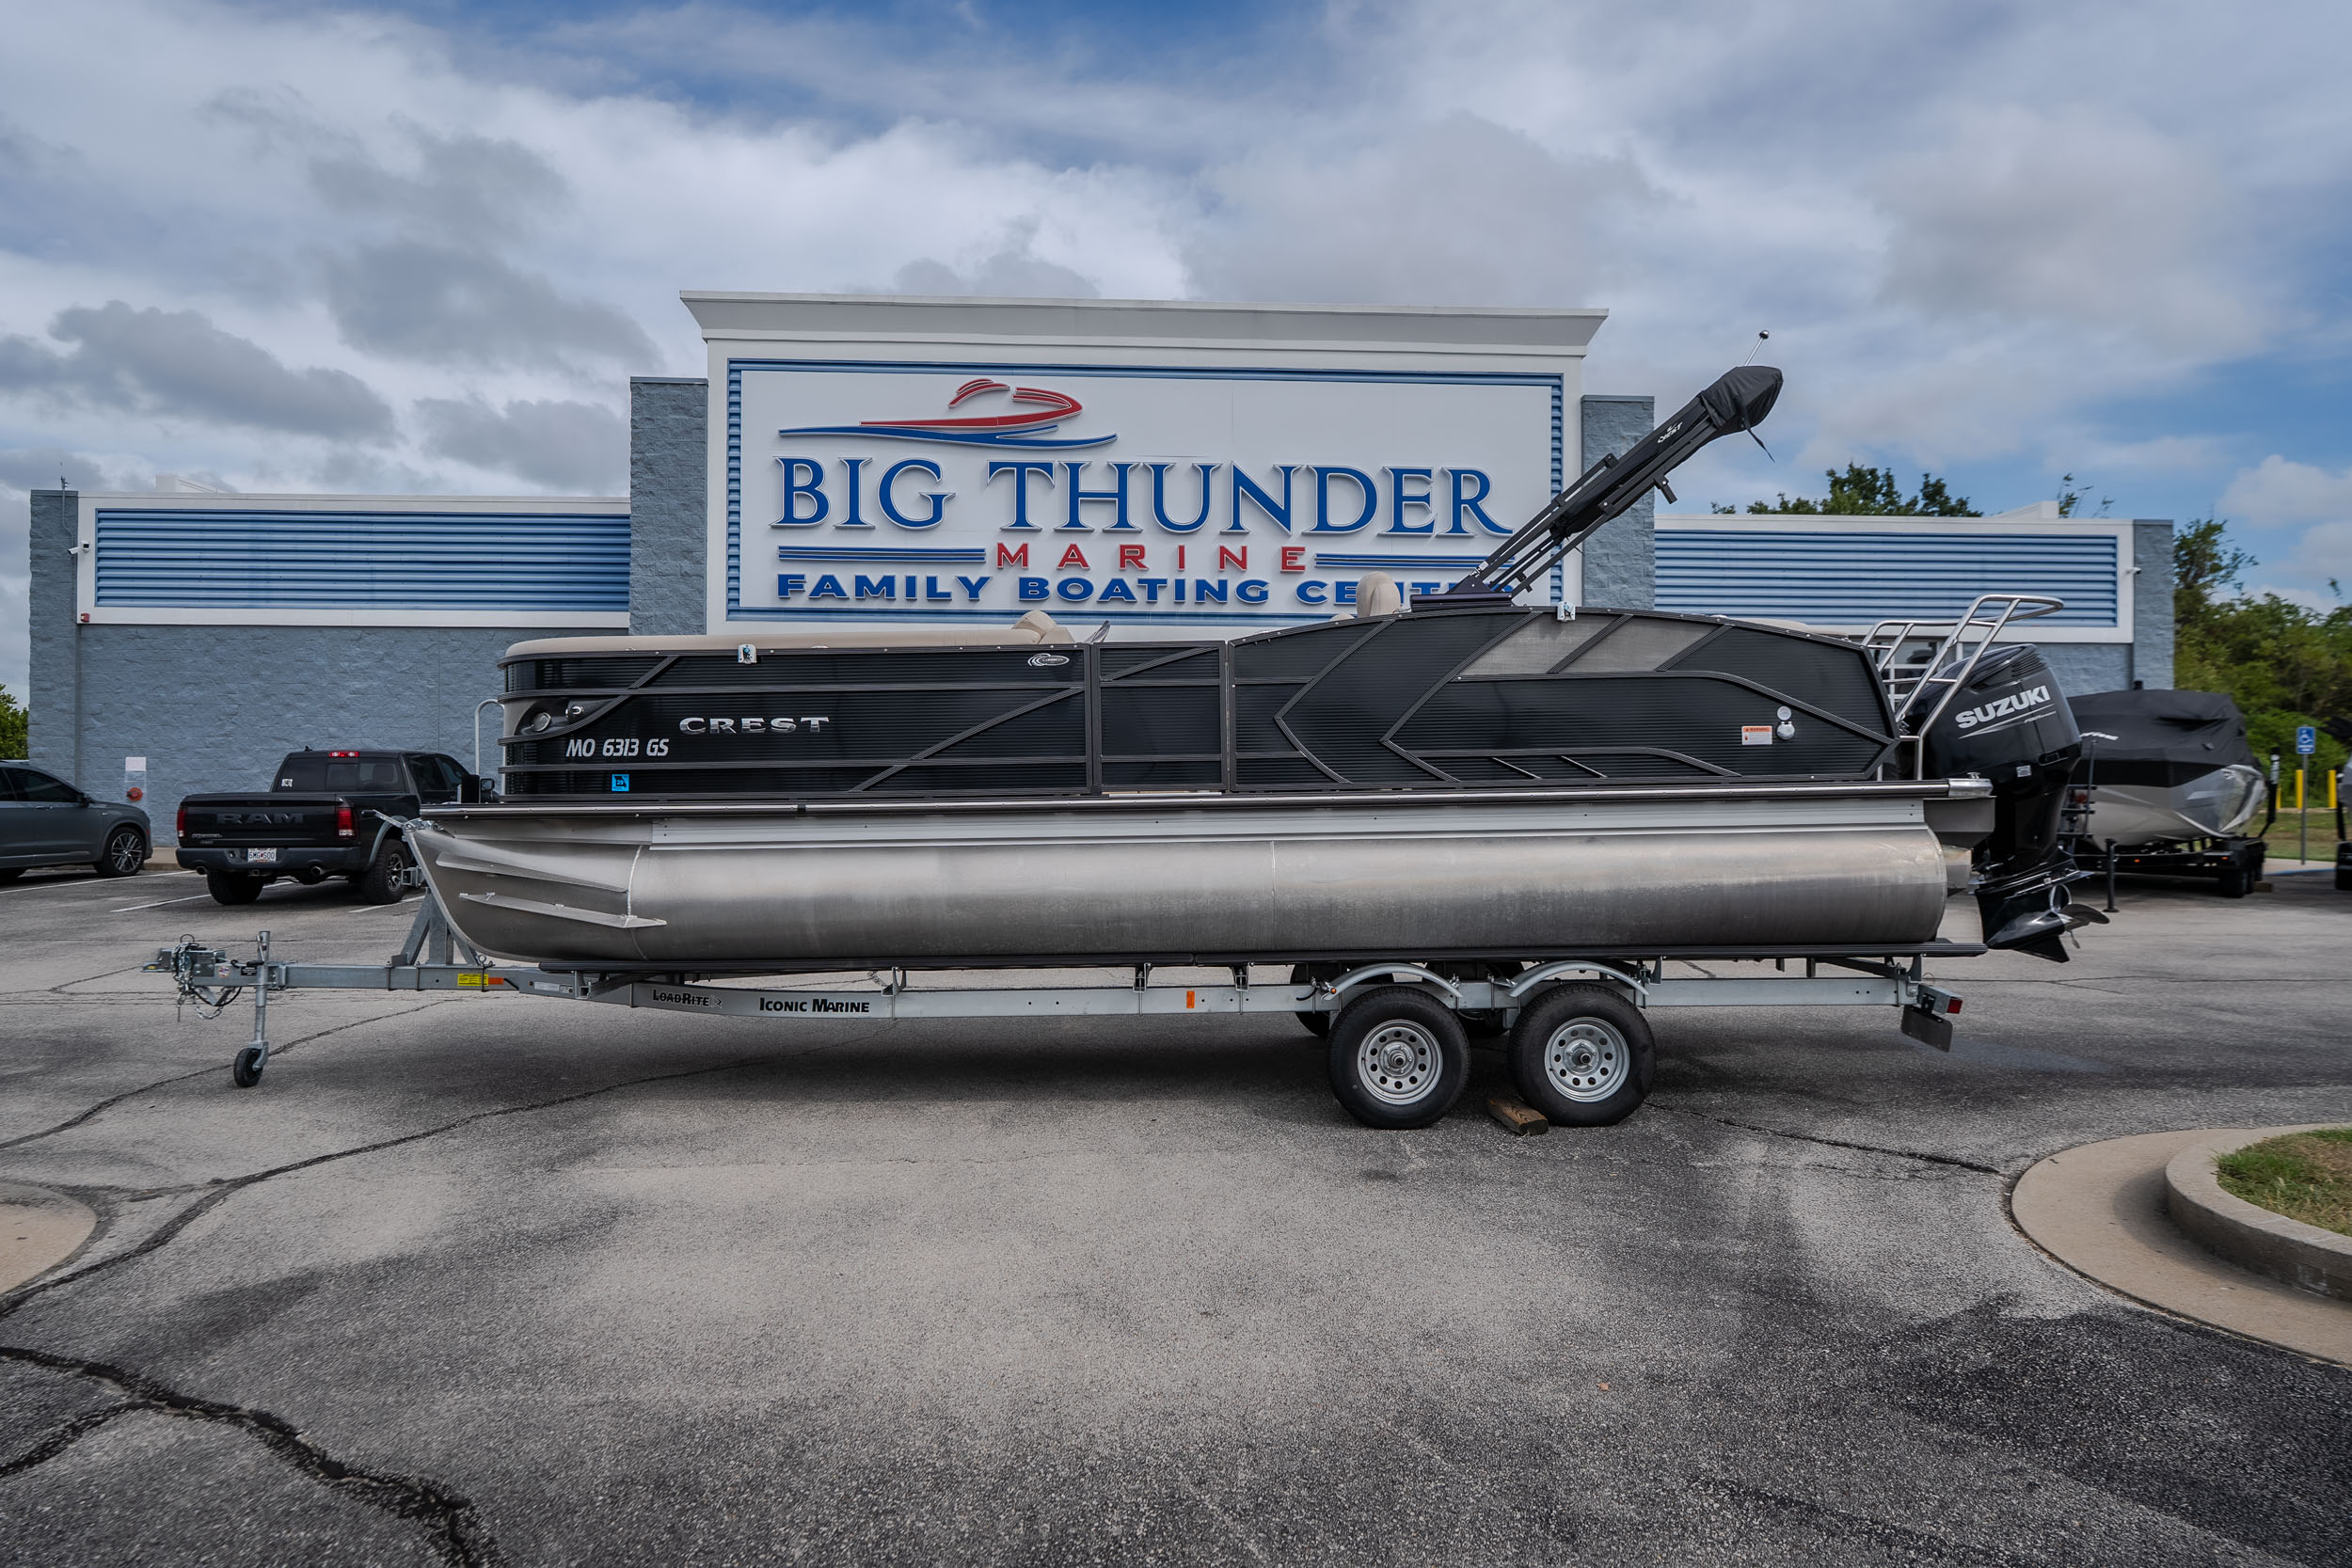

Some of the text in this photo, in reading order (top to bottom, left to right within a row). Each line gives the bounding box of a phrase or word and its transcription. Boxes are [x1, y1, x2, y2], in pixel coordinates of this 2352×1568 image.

[770, 456, 1514, 537] BIG THUNDER
[996, 542, 1307, 572] MARINE
[777, 574, 992, 601] FAMILY
[1018, 577, 1270, 604] BOATING
[1955, 685, 2051, 729] SUZUKI
[679, 717, 830, 735] CREST
[566, 738, 669, 757] MO 6313 GS
[216, 813, 303, 824] RAM
[759, 997, 869, 1013] ICONIC MARINE
